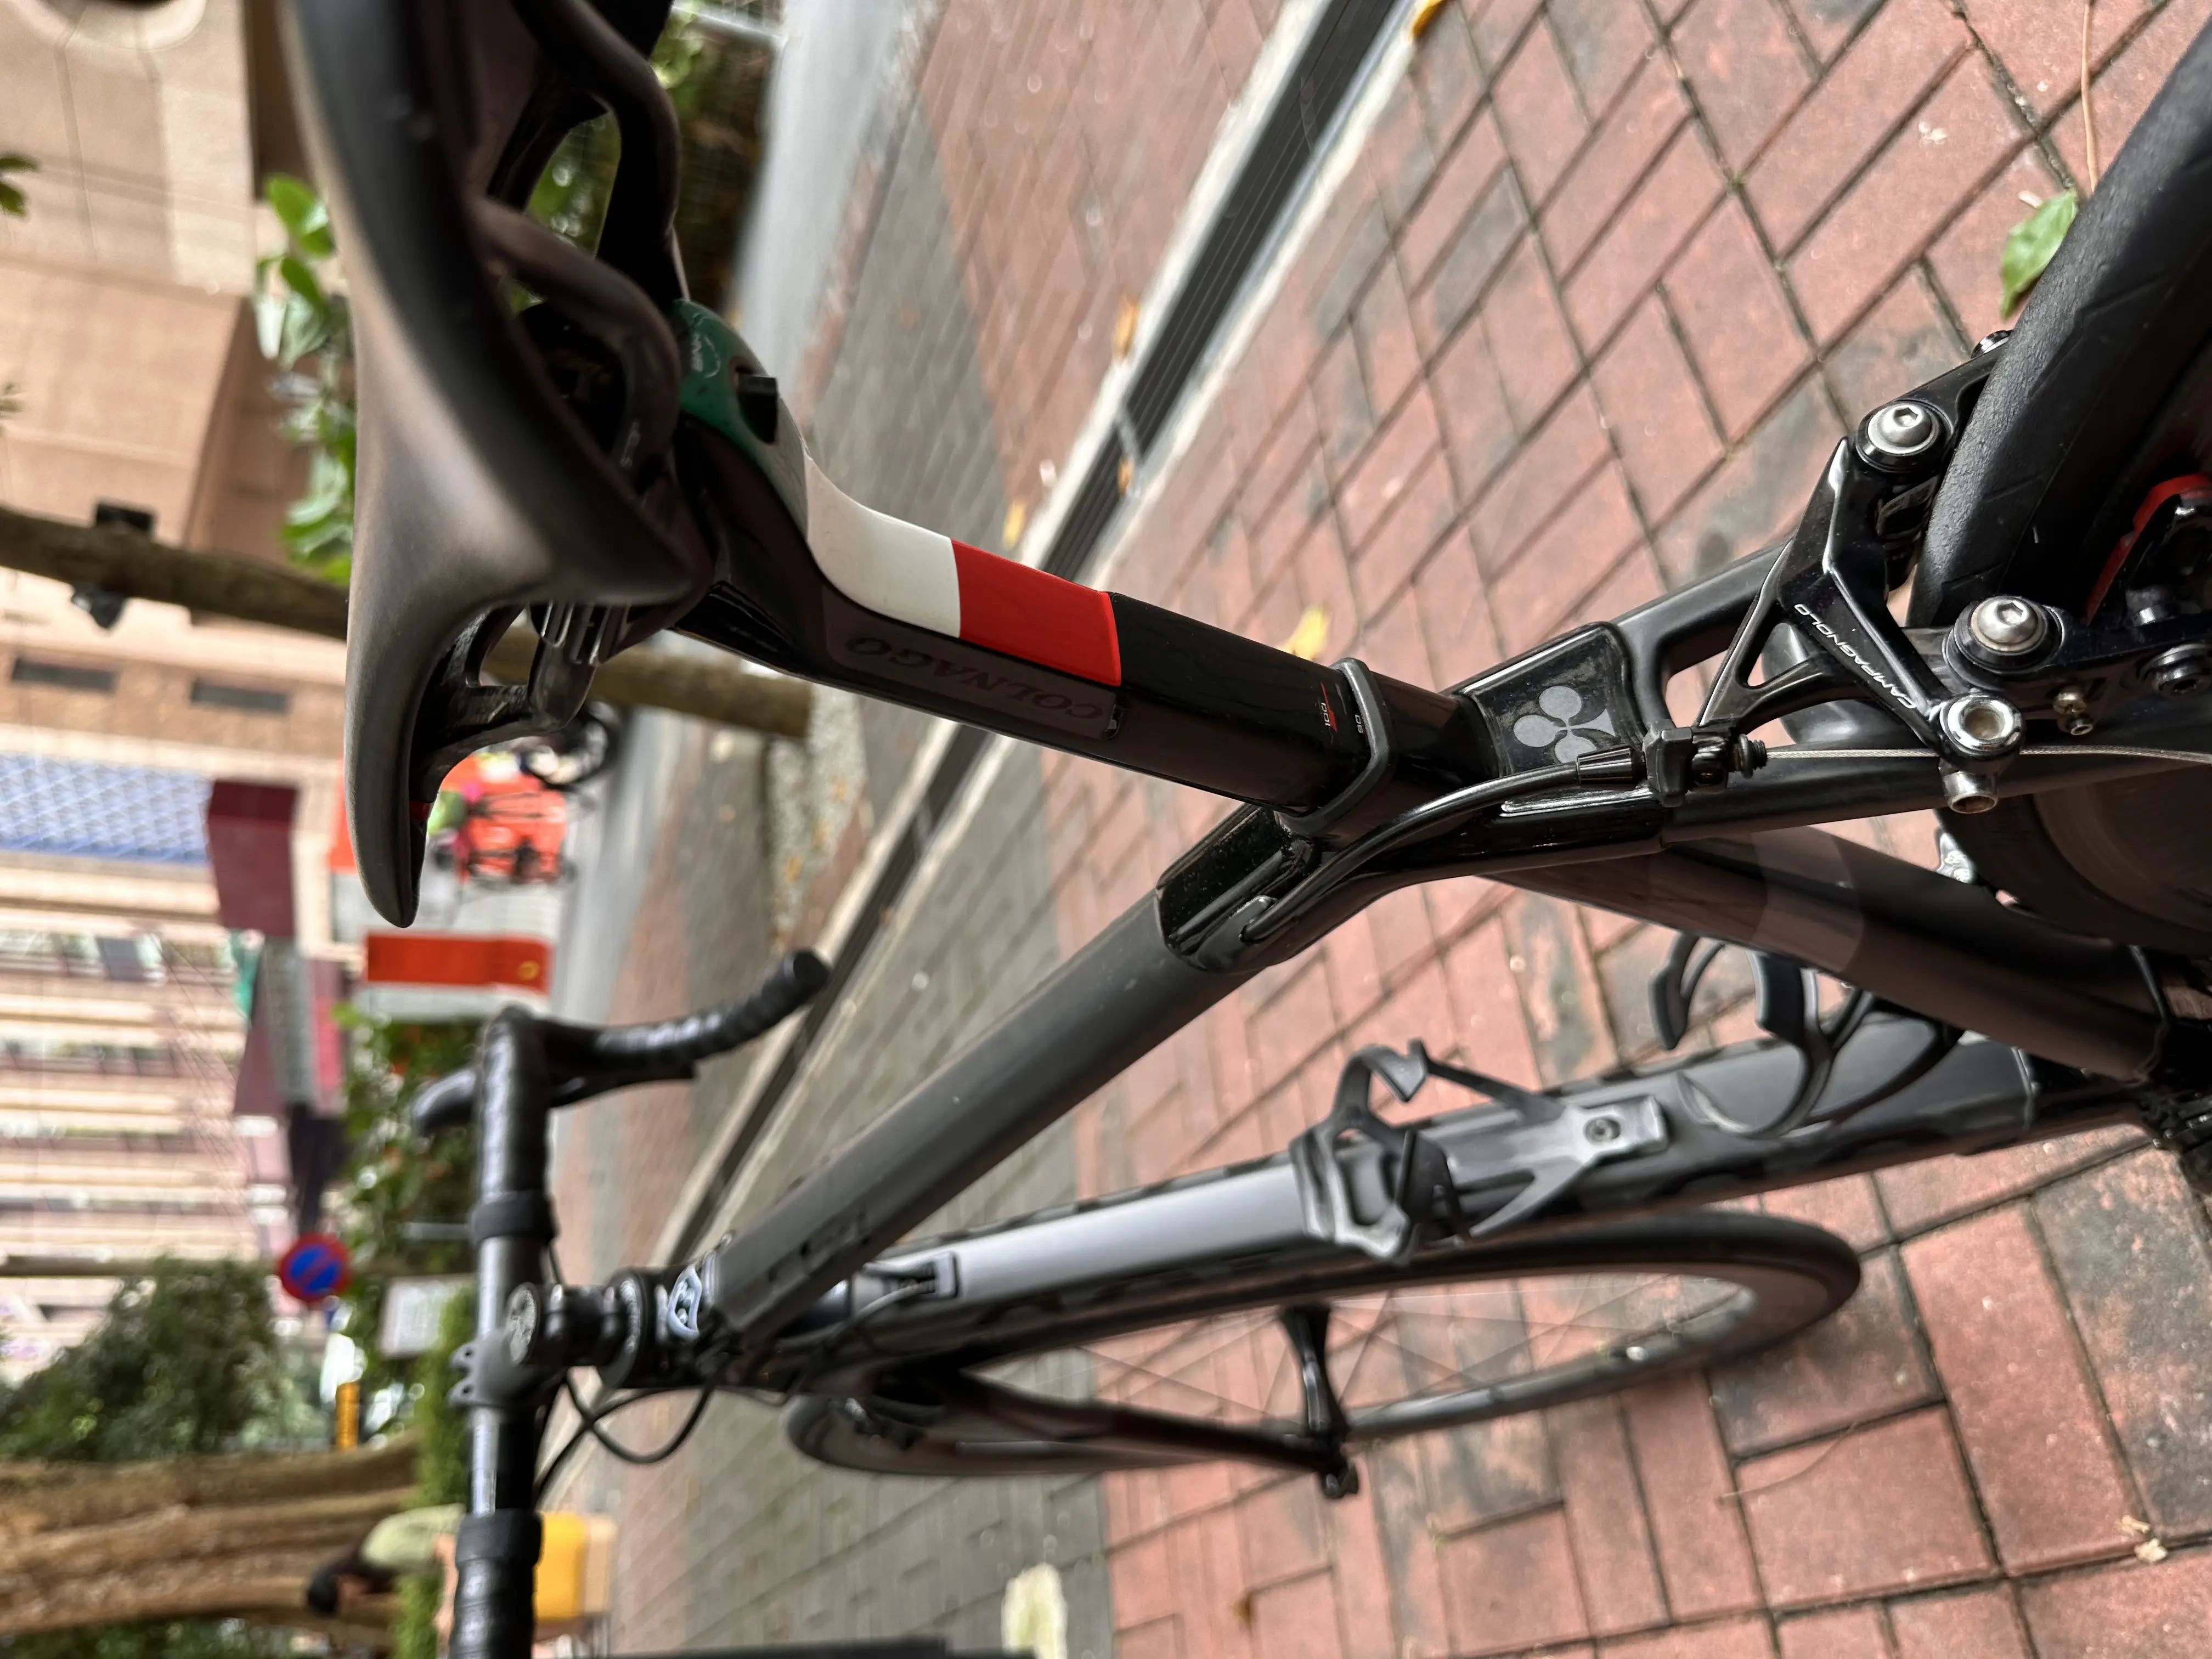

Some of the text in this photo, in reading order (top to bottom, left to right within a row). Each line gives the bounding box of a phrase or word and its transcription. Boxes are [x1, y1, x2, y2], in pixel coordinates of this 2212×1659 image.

[845, 635, 1103, 721] COLNAGO
[1794, 603, 1917, 709] CAMPAGNOLO
[1321, 702, 1330, 726] 100
